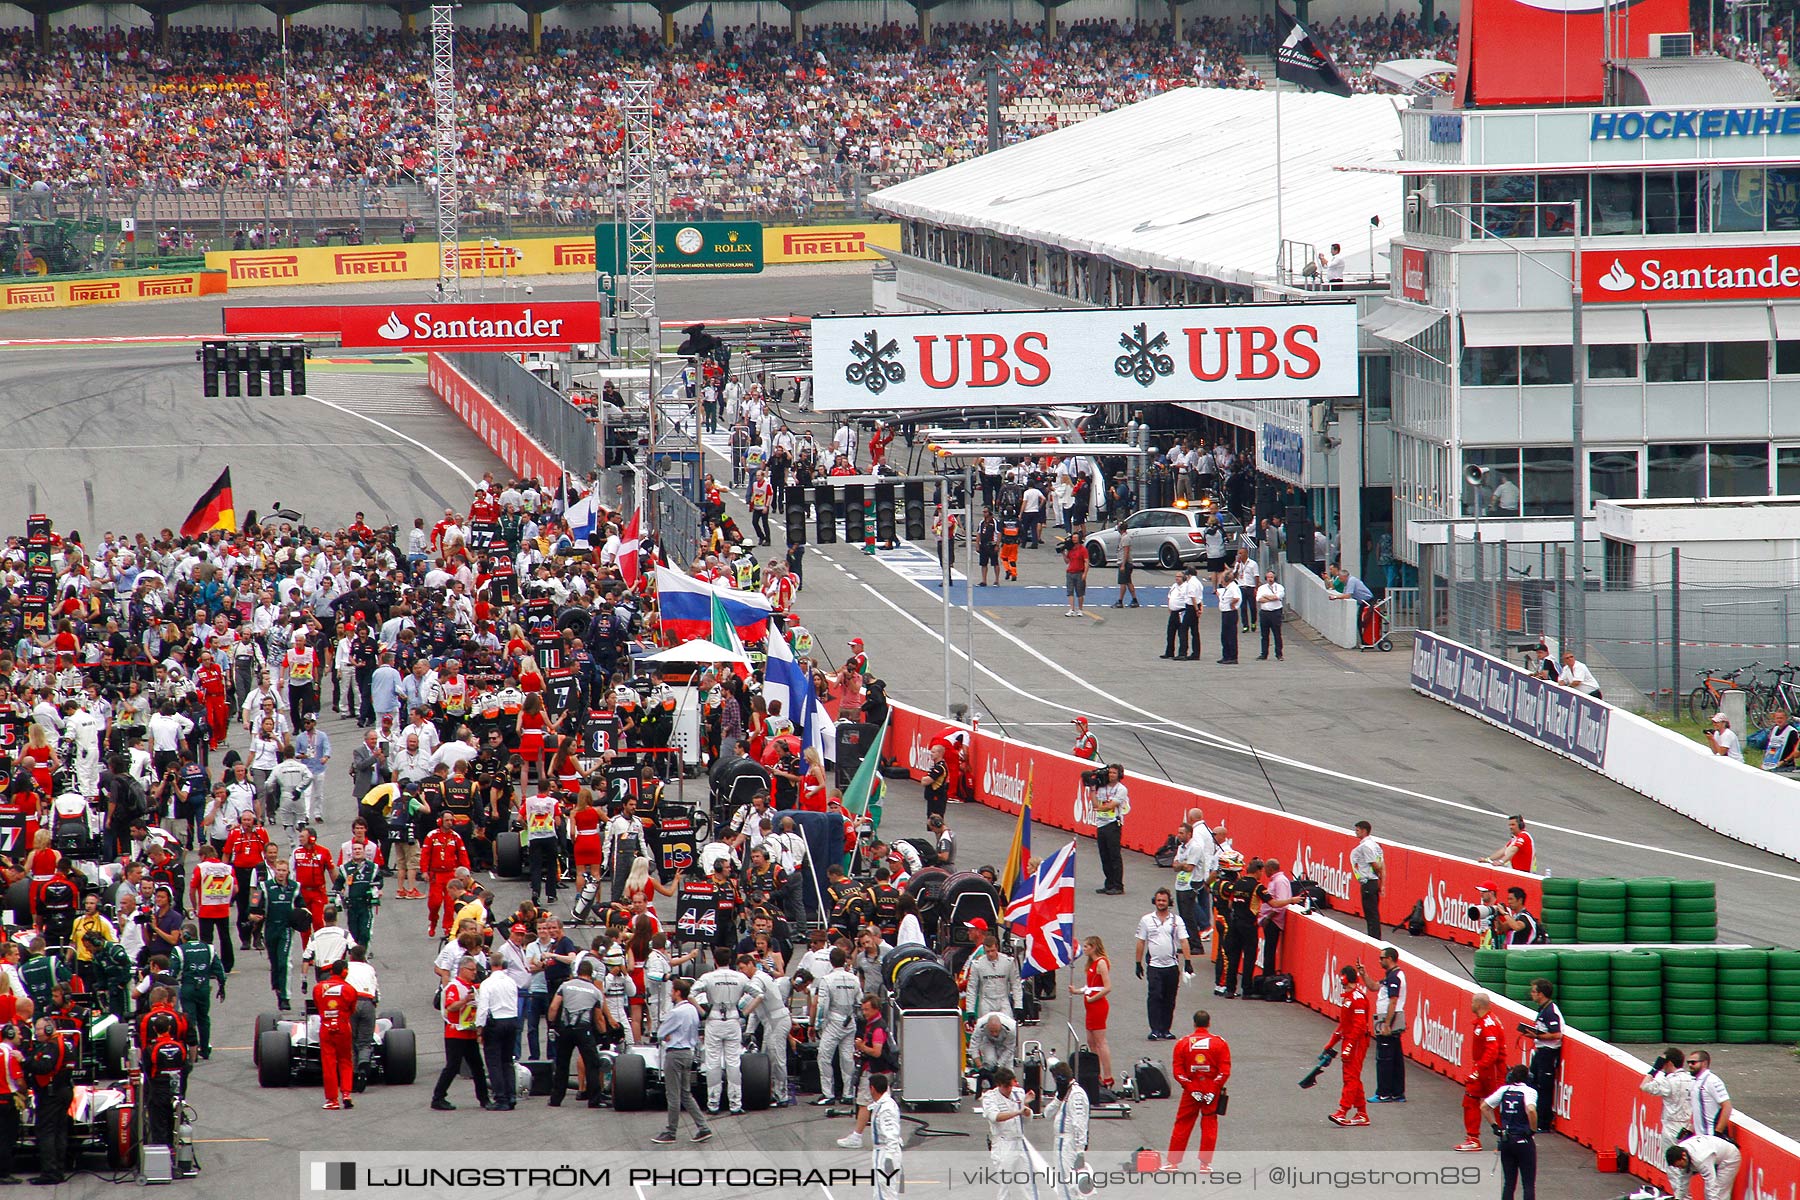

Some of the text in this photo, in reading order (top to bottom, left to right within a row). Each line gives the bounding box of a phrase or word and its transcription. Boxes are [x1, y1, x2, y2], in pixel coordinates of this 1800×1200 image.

[126, 220, 130, 228] 3
[714, 244, 752, 252] ROLEX
[783, 231, 866, 255] PIRELLI
[230, 256, 299, 280] PIRELLI
[334, 251, 408, 275] PIRELLI
[7, 286, 55, 304] PIRELLI
[70, 282, 120, 301] PIRELLI
[138, 278, 193, 297] PIRELLI
[414, 309, 563, 339] Santander
[913, 331, 1051, 389] UBS
[1182, 324, 1322, 382] UBS
[472, 530, 494, 547] 77
[24, 612, 46, 630] 14
[528, 614, 553, 634] 26
[1460, 656, 1482, 702] Allianz
[1486, 668, 1508, 714] Allianz
[554, 686, 570, 708] 7
[1515, 680, 1537, 728] Allianz
[1545, 690, 1568, 740] Allianz
[592, 730, 610, 752] 8
[1577, 704, 1600, 754] Allianz
[611, 778, 639, 802] 21
[991, 758, 1025, 804] Santander
[662, 842, 692, 869] 13
[1304, 845, 1352, 900] Santander
[678, 908, 717, 936] 44
[1422, 998, 1464, 1066] Santander
